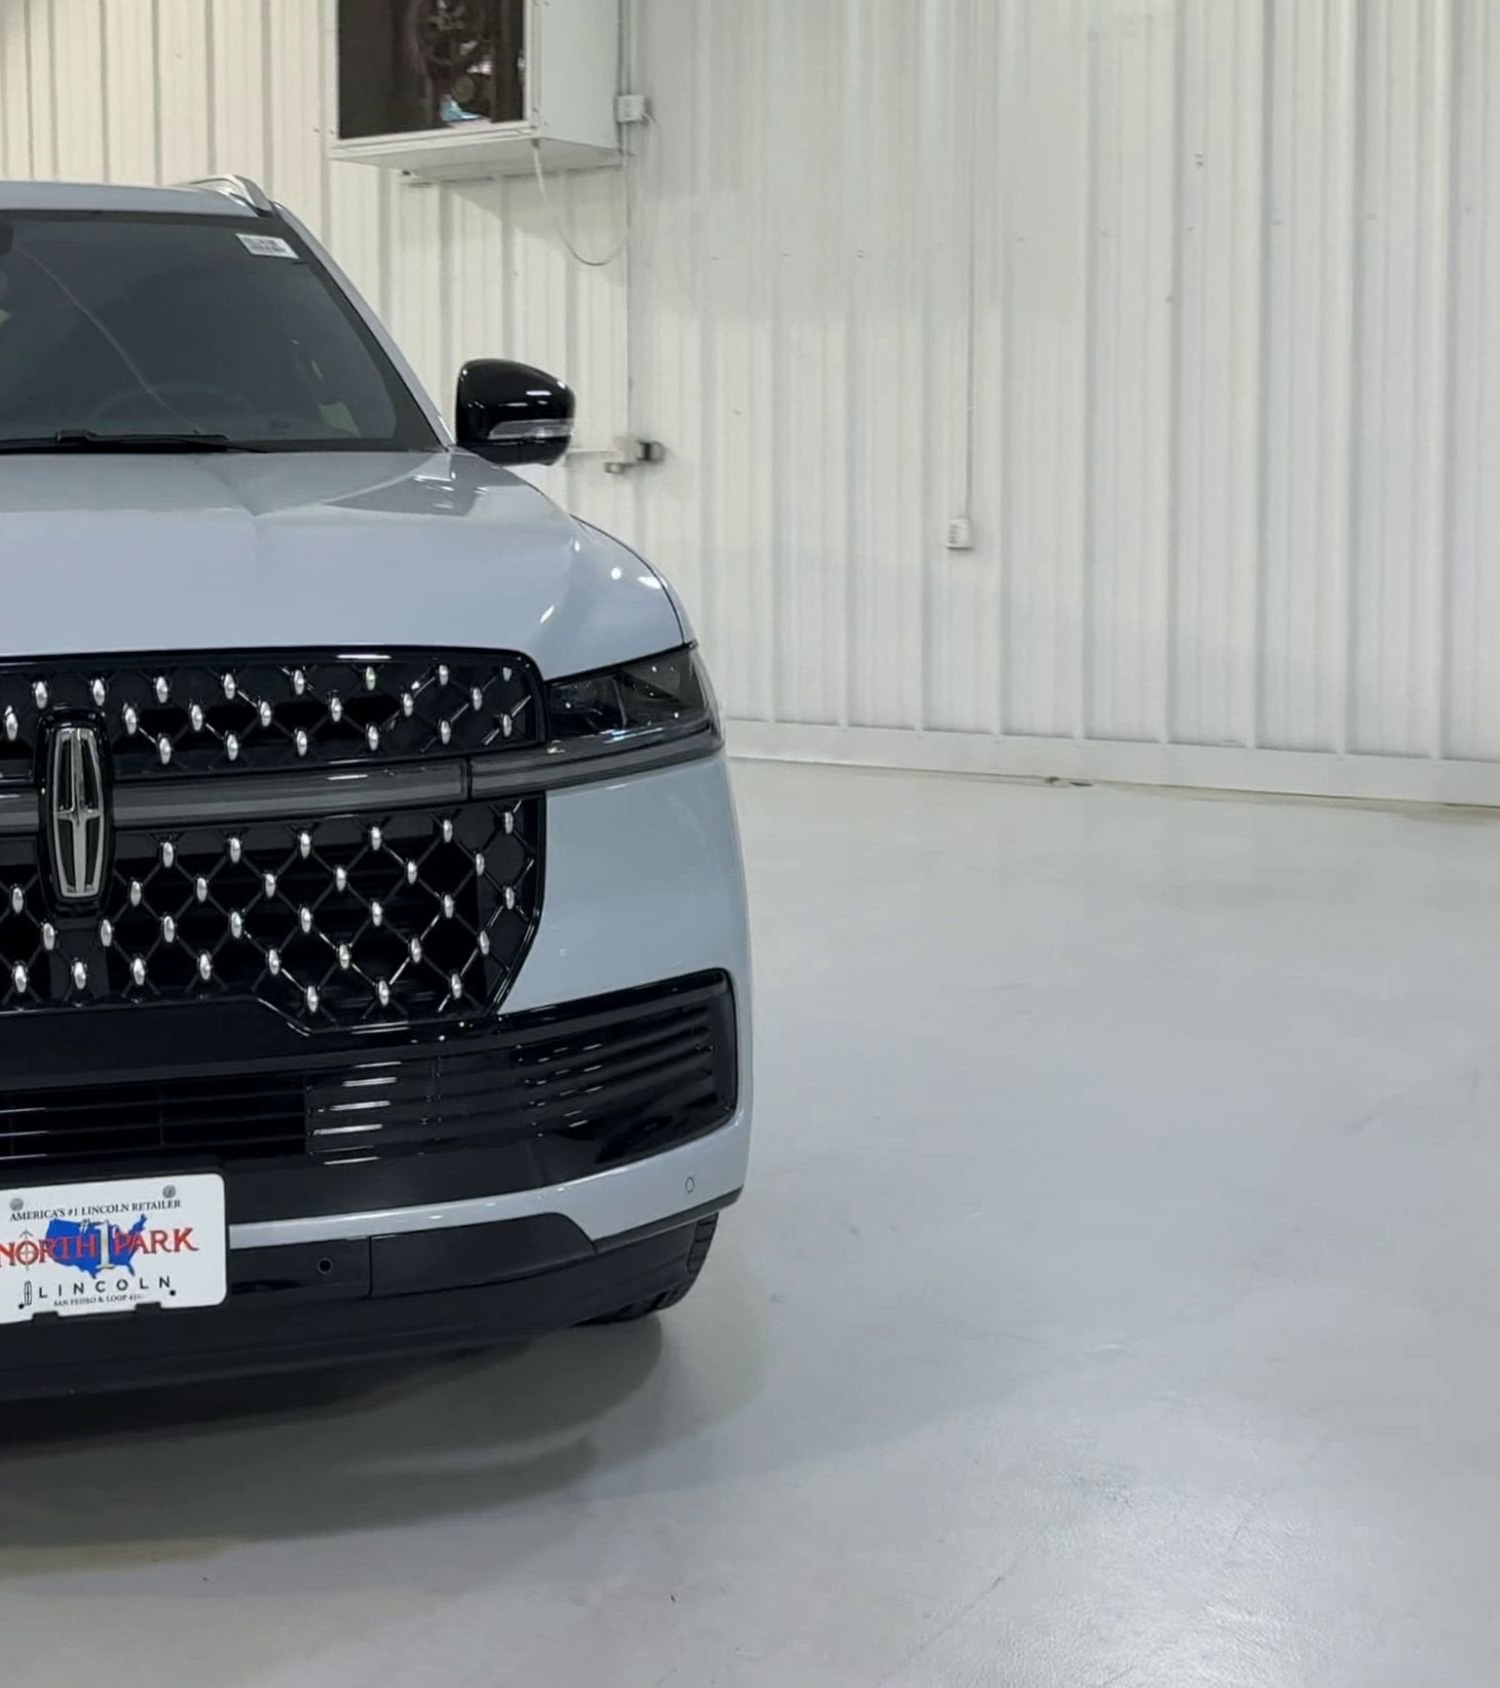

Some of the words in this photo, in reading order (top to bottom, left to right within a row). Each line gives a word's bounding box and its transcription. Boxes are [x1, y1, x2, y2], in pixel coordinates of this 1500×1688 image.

[10, 1207, 66, 1222] AMERICA'S
[68, 1208, 80, 1218] #1
[81, 1204, 130, 1217] LINCOLN
[132, 1199, 182, 1212] RETAILER
[115, 1227, 199, 1254] PARK
[39, 1276, 170, 1298] LINCOLN
